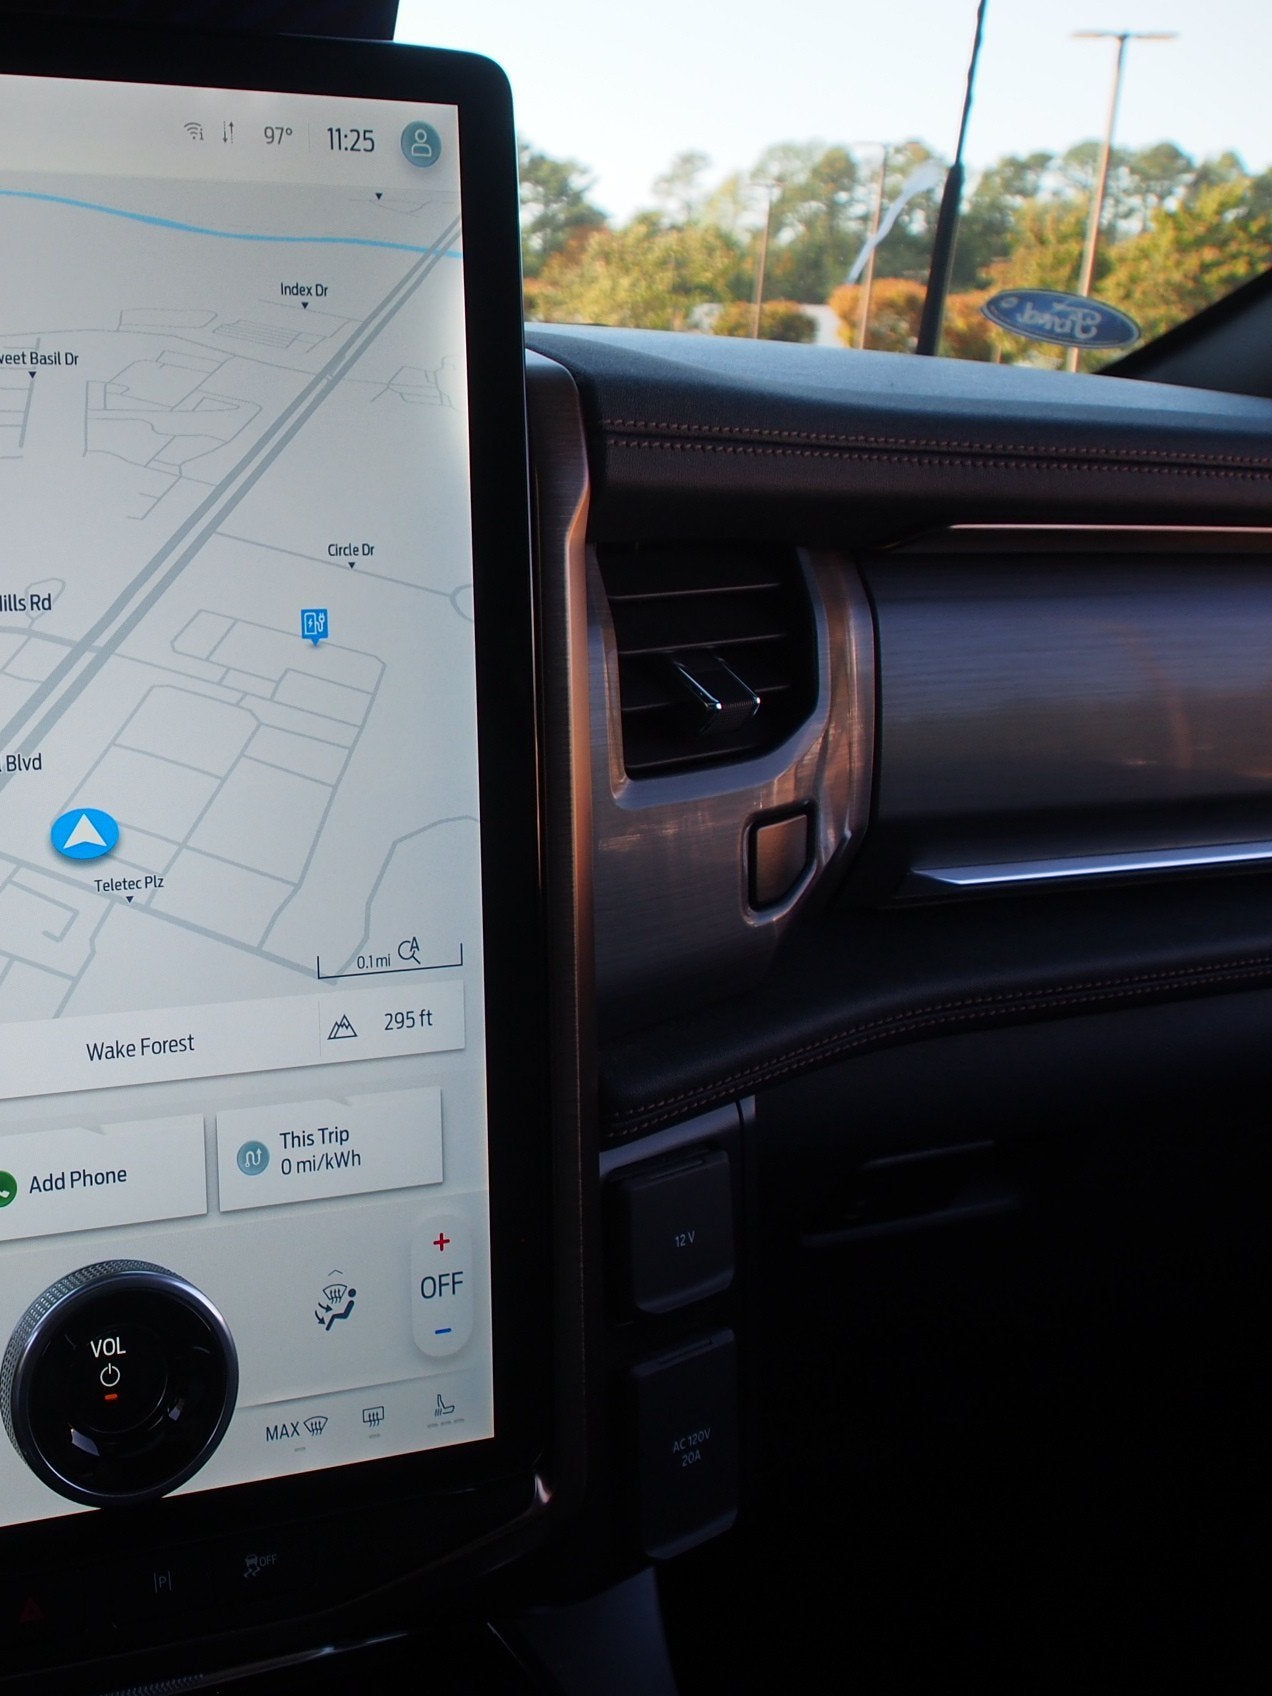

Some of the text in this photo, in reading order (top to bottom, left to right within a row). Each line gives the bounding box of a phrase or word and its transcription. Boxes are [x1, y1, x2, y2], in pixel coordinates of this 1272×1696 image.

[327, 126, 376, 153] 11:25
[280, 282, 328, 298] Index Dr
[29, 351, 62, 365] Basil
[64, 352, 79, 366] Dr
[328, 543, 375, 557] Circle Dr
[30, 593, 52, 612] Rd
[6, 753, 43, 772] Blvd
[94, 875, 165, 893] Teletec Plz
[357, 954, 391, 970] 0.1 mi
[384, 1009, 433, 1032] 295 ft
[86, 1034, 195, 1062] Wake Forest
[280, 1126, 350, 1150] This Trip
[281, 1149, 362, 1176] 0 mi/kWh
[28, 1168, 128, 1194] Add Phone
[675, 1229, 696, 1248] 12 V
[420, 1271, 464, 1300] OFF
[90, 1336, 127, 1359] VOL
[265, 1420, 300, 1443] MAX
[672, 1426, 711, 1454] AC 120V
[681, 1449, 702, 1468] 20A
[259, 1553, 277, 1567] OFF
